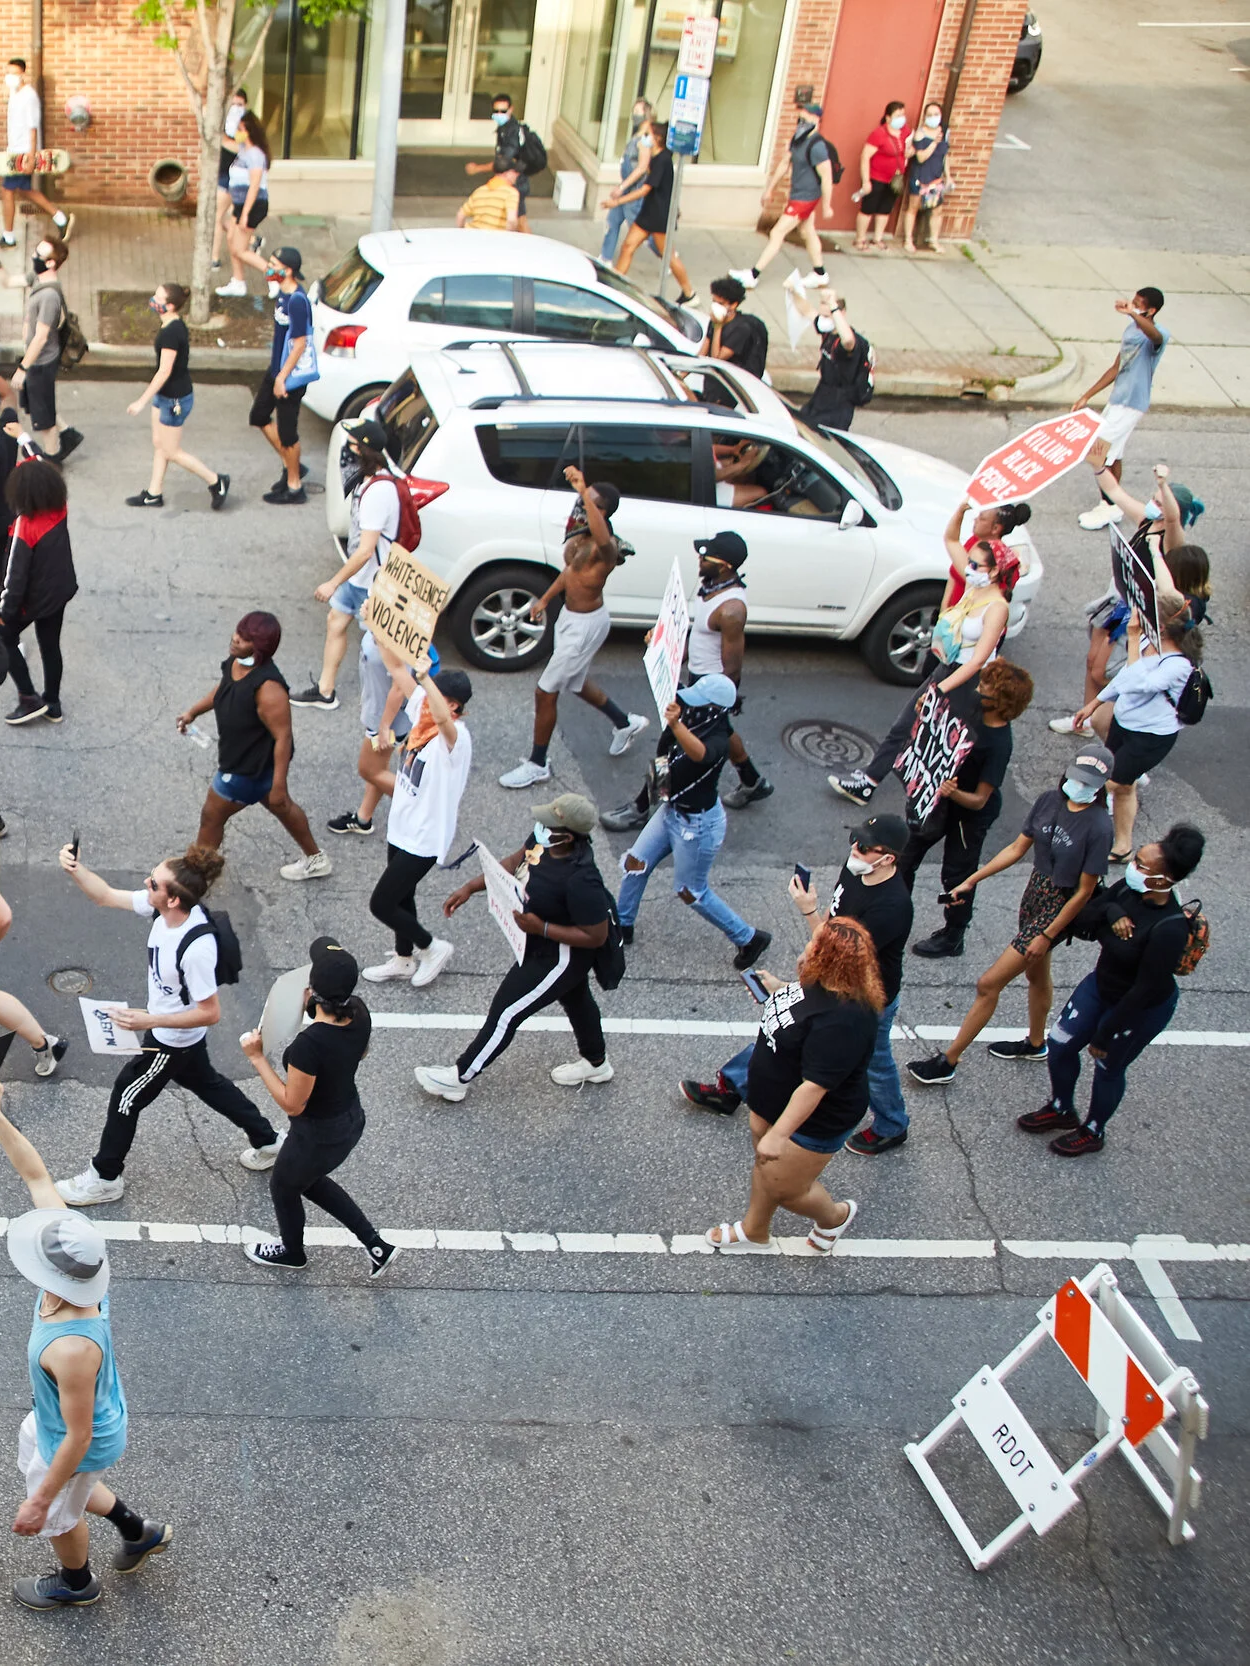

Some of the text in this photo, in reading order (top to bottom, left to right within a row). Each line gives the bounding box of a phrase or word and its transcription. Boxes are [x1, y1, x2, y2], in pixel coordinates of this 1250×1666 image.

[1023, 429, 1074, 466] KILLING
[1055, 418, 1091, 443] STOP
[974, 466, 1018, 500] PEOPLE
[1002, 449, 1045, 482] BLACK
[384, 552, 415, 589] WHITE
[1122, 562, 1146, 611] LIVES
[371, 596, 428, 659] VIOLENCE
[919, 685, 975, 768] BLACK
[991, 1423, 1035, 1478] RDOT
